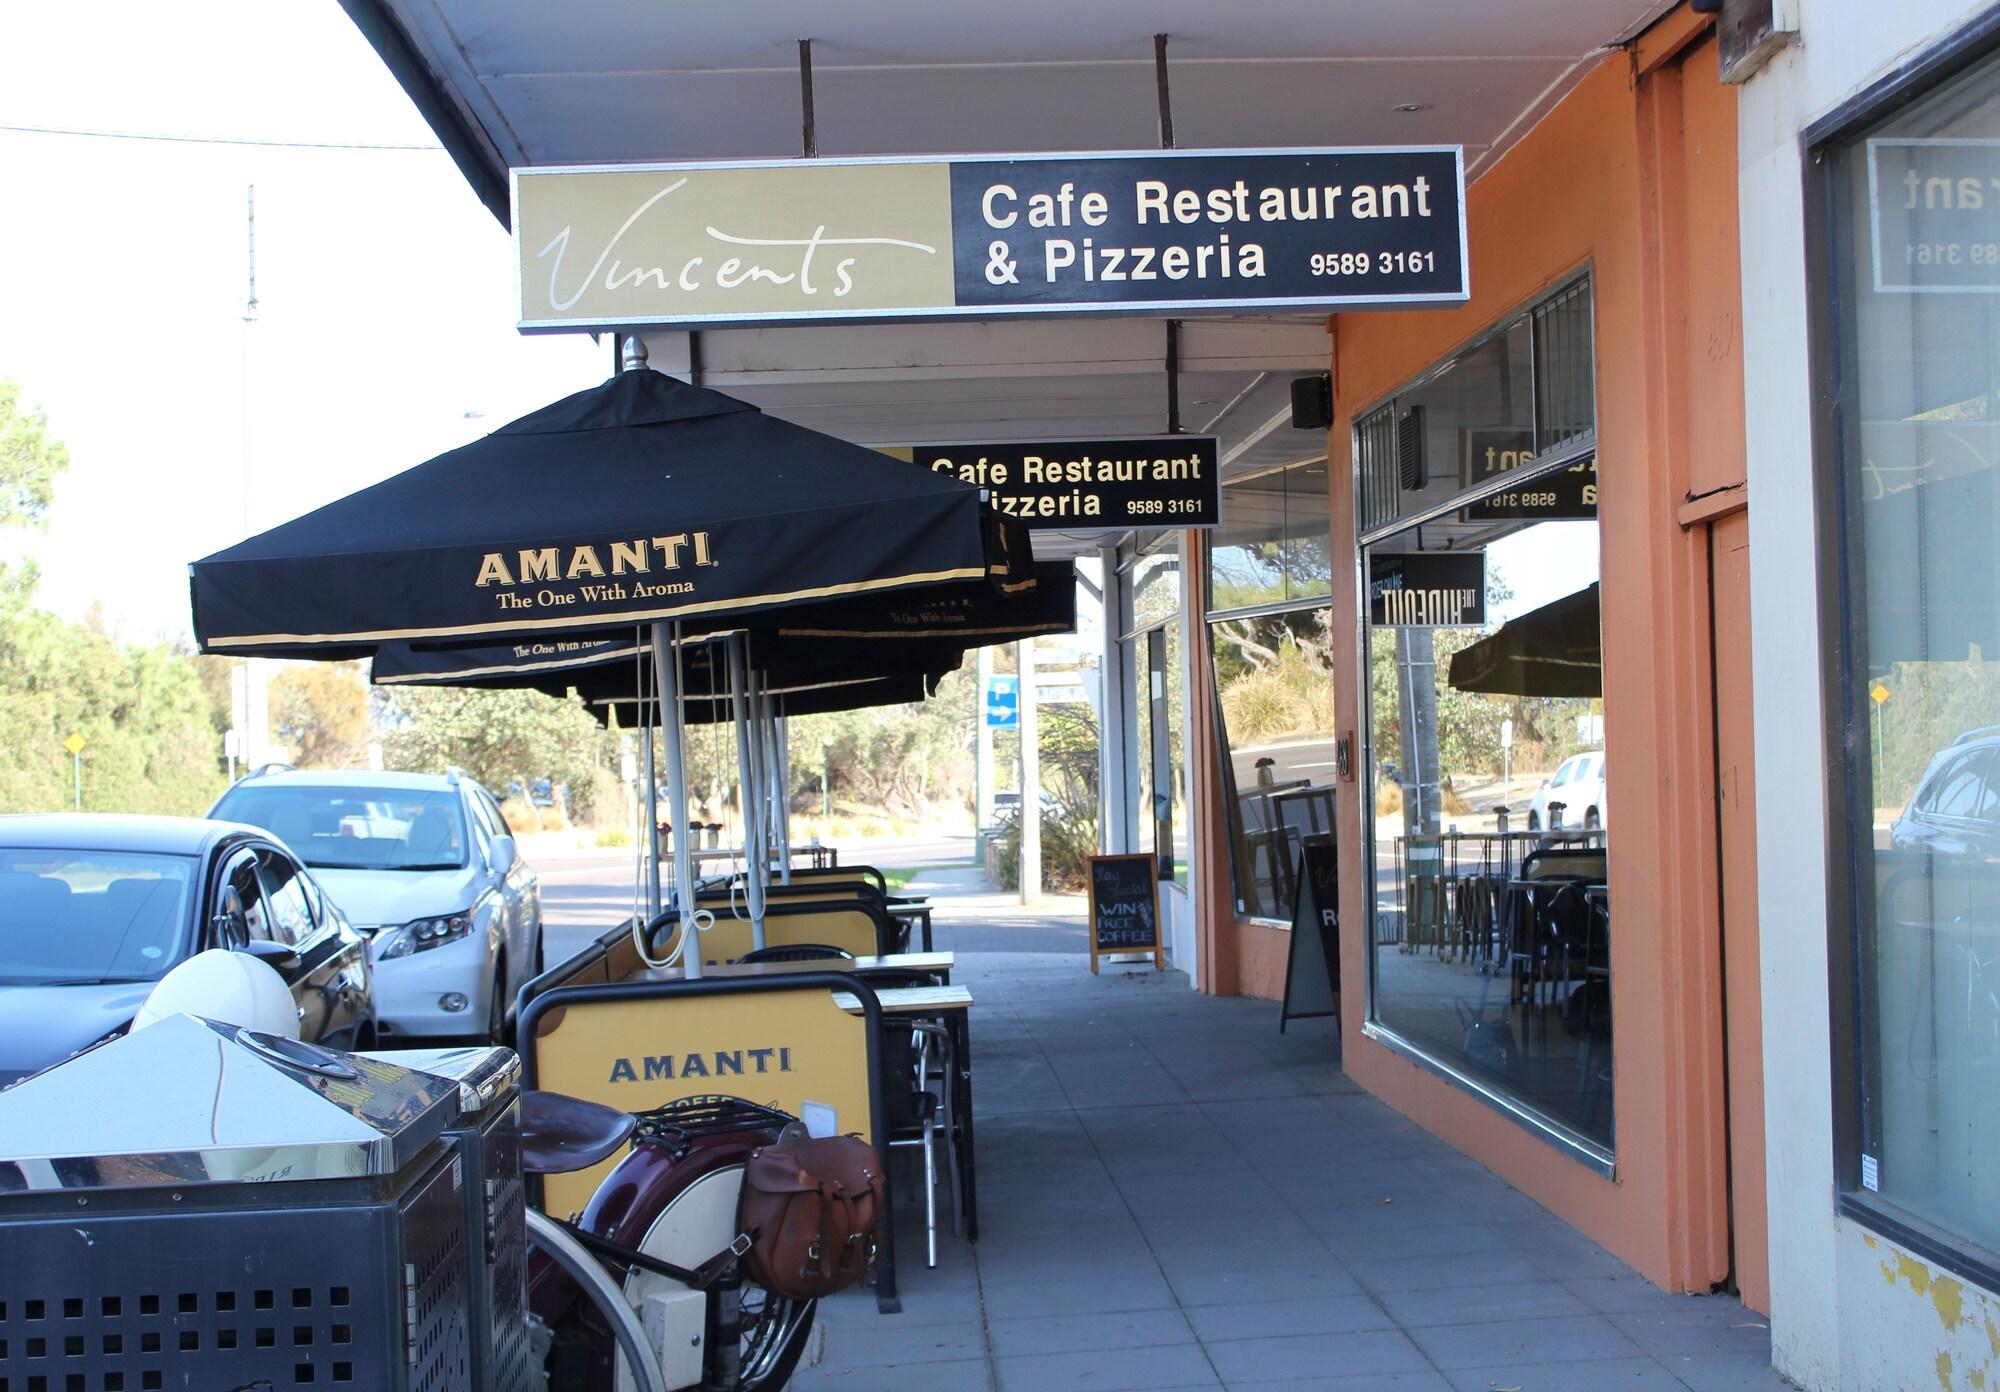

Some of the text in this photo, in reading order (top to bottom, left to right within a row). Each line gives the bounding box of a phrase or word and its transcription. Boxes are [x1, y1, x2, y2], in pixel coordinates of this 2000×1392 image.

[981, 175, 1432, 229] Cafe Restaurant
[536, 177, 936, 312] Vincents
[984, 234, 1267, 285] & Pizzeria
[1310, 251, 1434, 276] 9589 3161
[1023, 453, 1201, 483] Restaurant
[991, 488, 1101, 517] izzeria
[1126, 499, 1202, 515] 9589 3161
[475, 532, 712, 587] AMANTI
[496, 581, 695, 609] The One With Aroma
[513, 645, 531, 658] The
[532, 643, 555, 655] One
[557, 642, 579, 652] With
[1097, 917, 1135, 929] FREE
[1099, 903, 1137, 915] WIN
[1097, 929, 1153, 943] COFFEE
[609, 1047, 791, 1083] AMANTI
